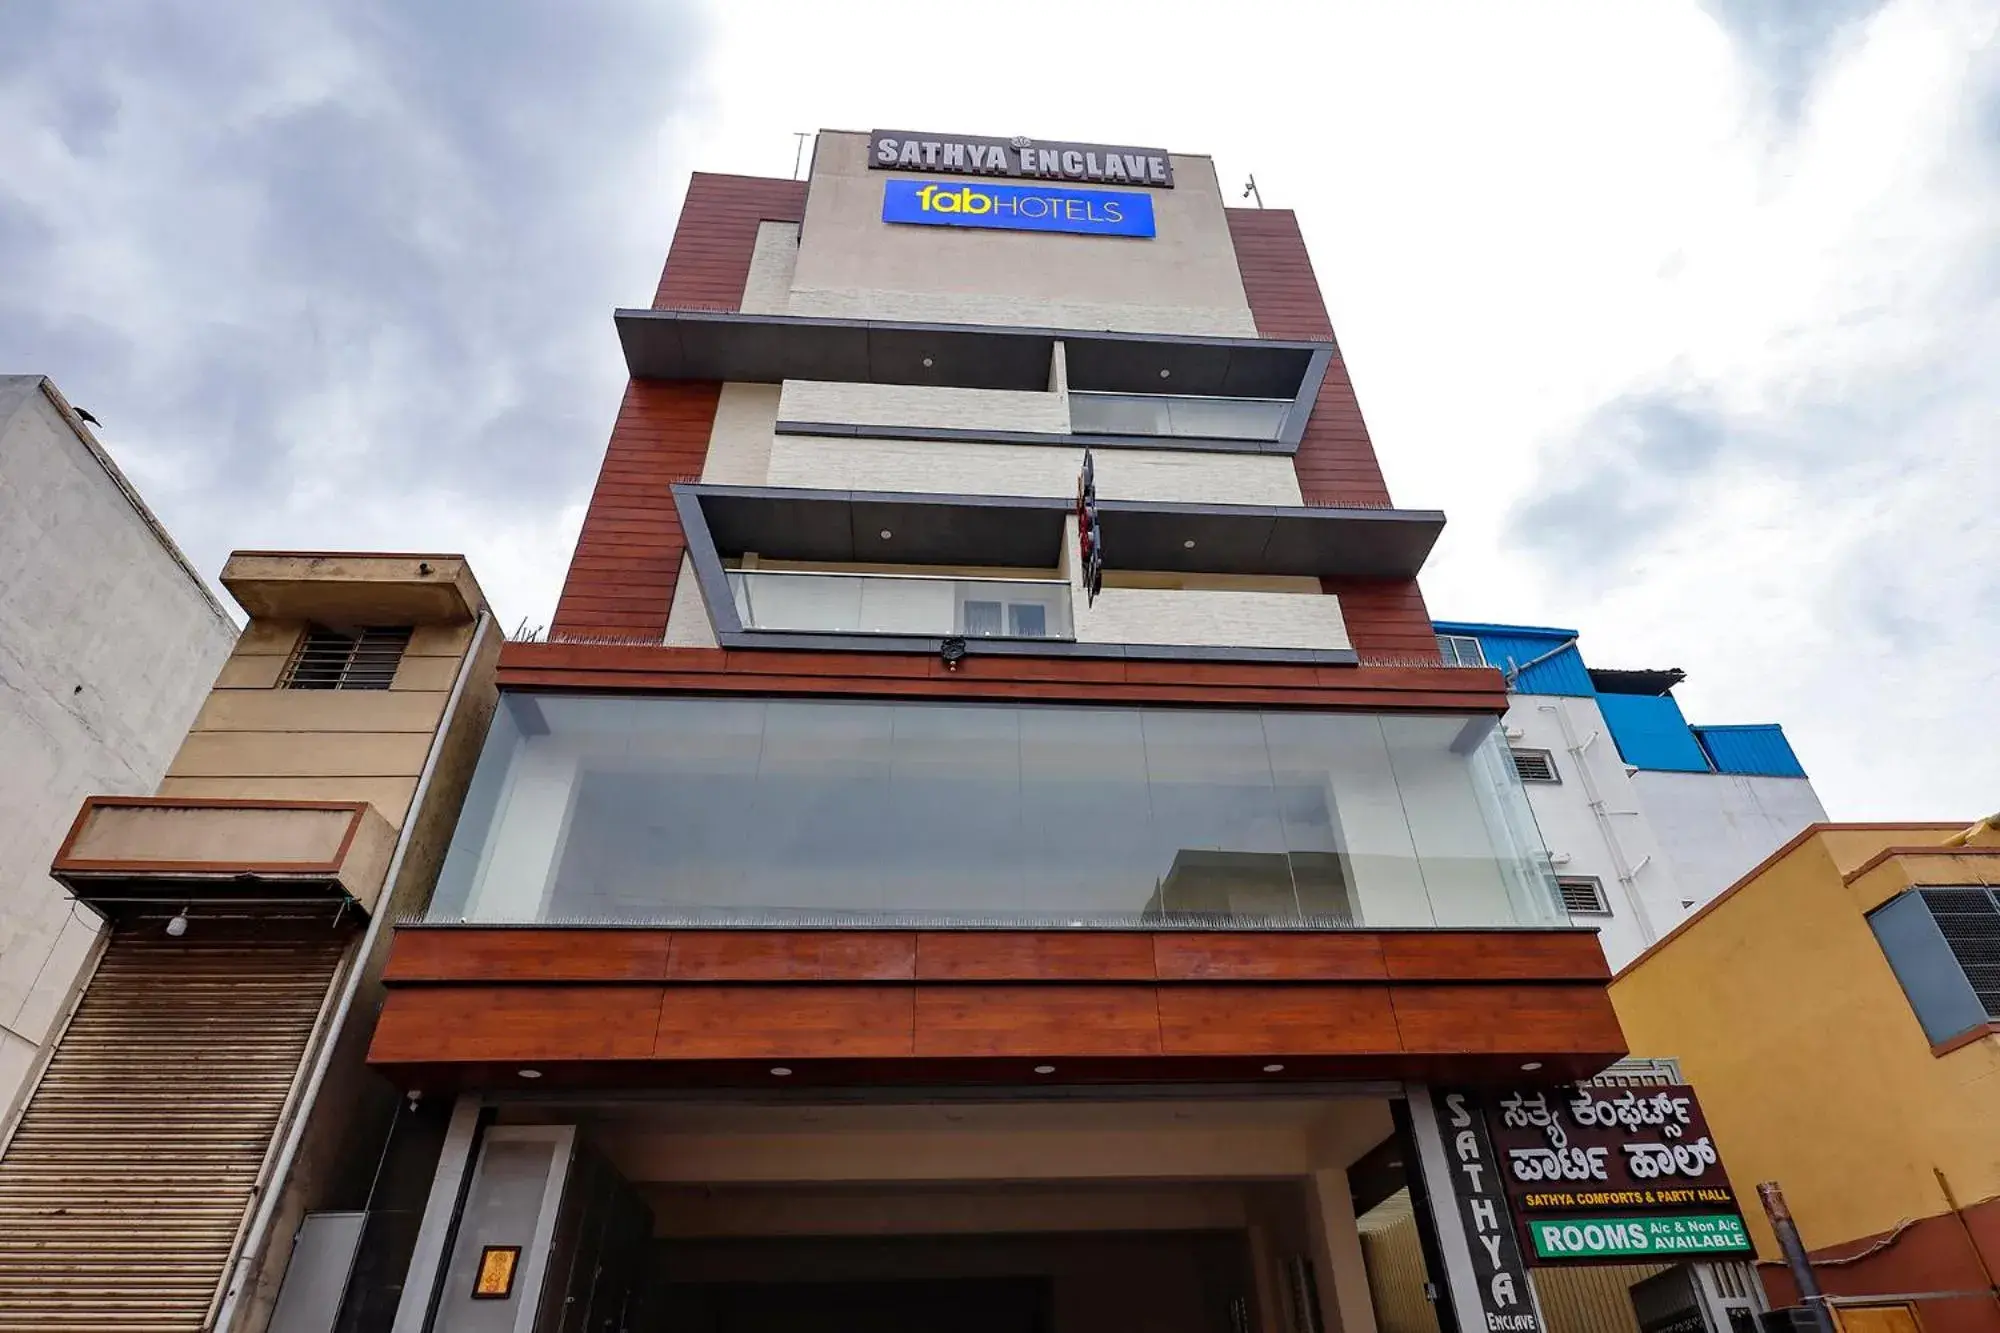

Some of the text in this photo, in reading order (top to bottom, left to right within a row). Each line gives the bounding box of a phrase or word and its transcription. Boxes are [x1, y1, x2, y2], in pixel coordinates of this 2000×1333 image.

[878, 138, 1167, 182] SATHYA ENCLAVE
[916, 185, 1123, 222] fabHOTELS
[1500, 1091, 1567, 1148] ಸತ್ಯ
[1623, 1136, 1716, 1179] ಹಾಲ್
[1446, 1094, 1517, 1308] SATHYA
[1525, 1189, 1731, 1206] SATHYA COMFORTS & PARTY HALL
[1541, 1219, 1739, 1251] ROOMS A/c & Non A/c
[1655, 1234, 1746, 1249] AVAILABLE
